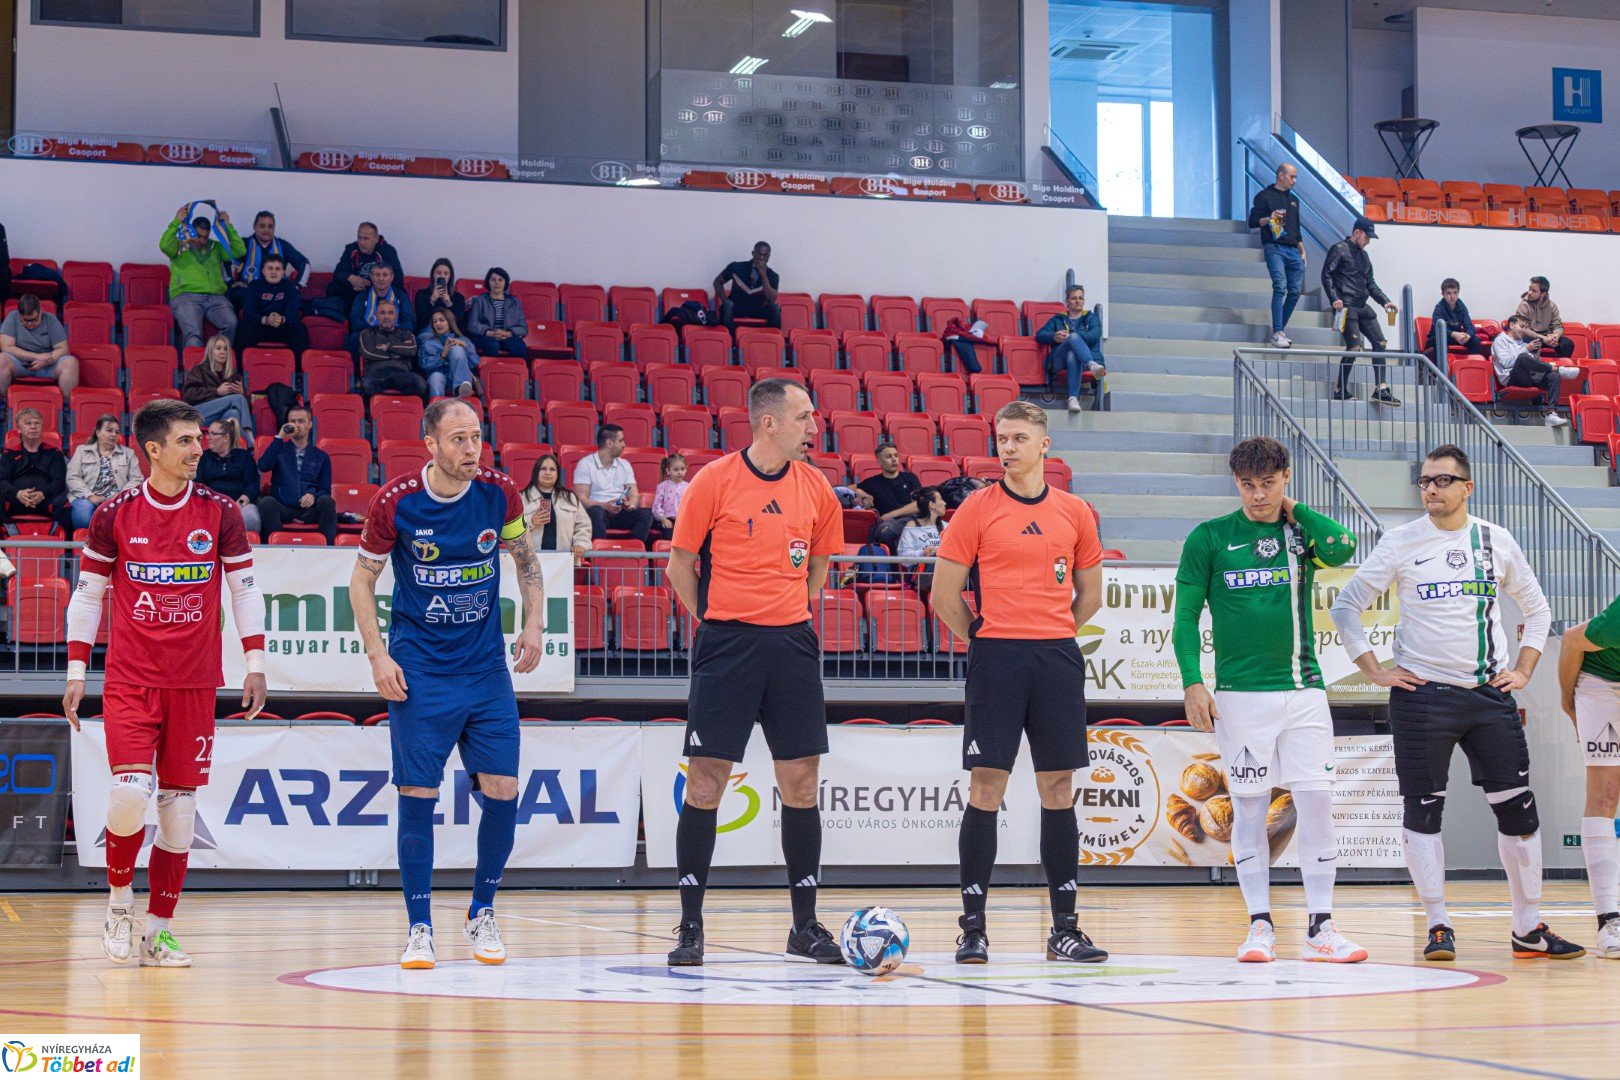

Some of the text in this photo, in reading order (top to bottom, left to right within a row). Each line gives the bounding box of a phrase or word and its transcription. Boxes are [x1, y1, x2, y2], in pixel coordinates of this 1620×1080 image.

[16, 138, 44, 154] BH
[68, 147, 107, 157] Csoport
[168, 143, 195, 160] BH
[219, 154, 256, 164] Csoport
[319, 152, 345, 167] BH
[521, 159, 556, 169] Holding
[368, 162, 405, 171] Csoport
[461, 159, 487, 174] BH
[598, 165, 625, 180] BH
[509, 168, 545, 178] Csoport
[733, 171, 760, 186] BH
[792, 172, 826, 182] Holding
[780, 181, 815, 191] Csoport
[867, 177, 891, 193] BH
[924, 179, 957, 189] Holding
[1032, 183, 1085, 195] Bige Holding
[996, 184, 1020, 199] BH
[1042, 194, 1075, 204] Csoport
[132, 610, 203, 623] STUDIO
[425, 607, 490, 624] STUDIO
[1119, 628, 1134, 645] a
[268, 638, 330, 655] agyar
[1085, 658, 1126, 690] AK
[1131, 683, 1166, 691] Nonprofit
[195, 735, 214, 762] 22
[1369, 744, 1395, 752] KÉSZÜ
[1089, 748, 1145, 787] OVÁSZOS
[1335, 767, 1396, 775] ÁSZOS KENYERE
[1332, 790, 1365, 798] MENTES
[1371, 811, 1381, 820] ÉS
[1382, 810, 1402, 820] KÁVÉ
[857, 817, 897, 829] VÁROS
[1079, 813, 1146, 848] MŰHELY
[1336, 835, 1401, 846] YÍREGYHÁZA,
[1337, 848, 1373, 857] AZONYI
[1376, 847, 1389, 857] ÚT
